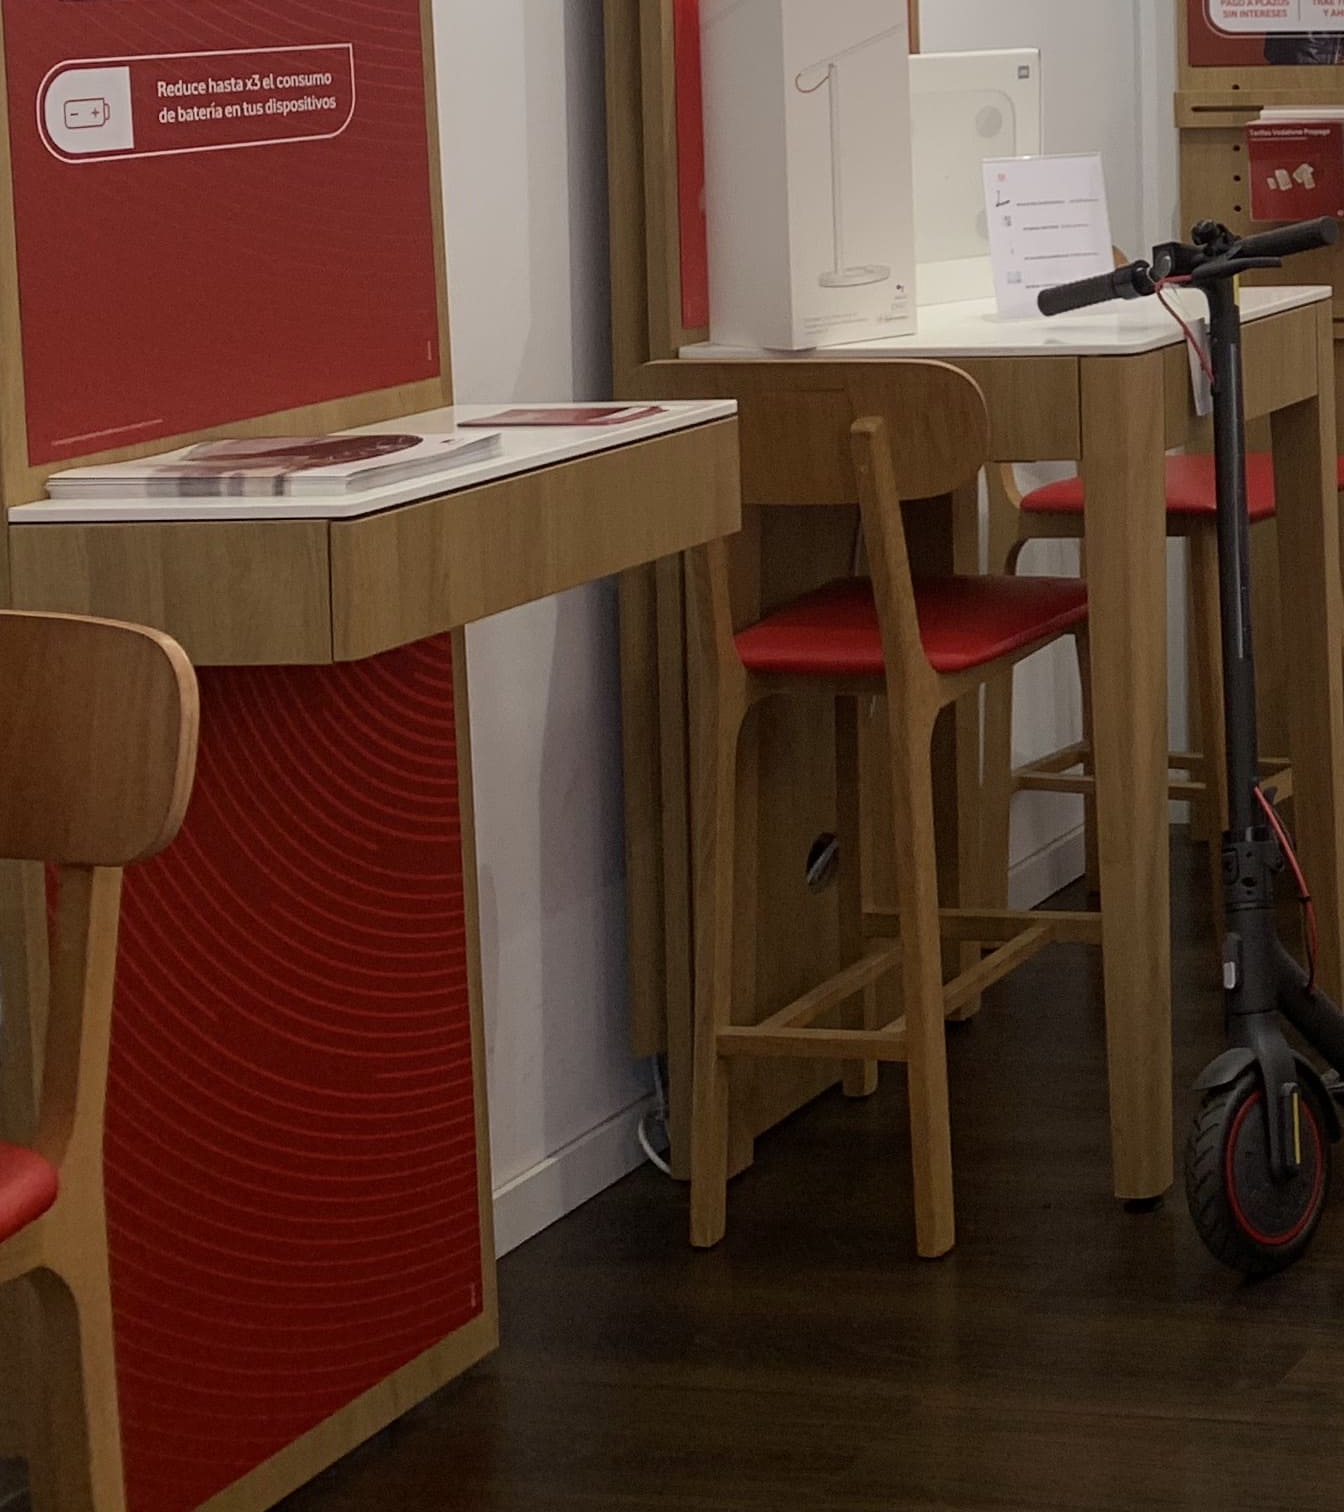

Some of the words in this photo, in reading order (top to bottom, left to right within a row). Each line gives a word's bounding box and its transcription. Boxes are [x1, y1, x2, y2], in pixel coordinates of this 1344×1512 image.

[1223, 9, 1238, 18] SIN
[1239, 9, 1288, 19] INTERESES
[157, 80, 207, 98] Reduce
[208, 77, 243, 94] hasta
[245, 74, 261, 91] x3
[262, 73, 274, 89] el
[276, 72, 332, 88] consumo
[159, 108, 176, 124] de
[178, 103, 223, 122] batería
[225, 104, 241, 118] en
[243, 101, 263, 117] tus
[265, 96, 337, 116] dispositivos
